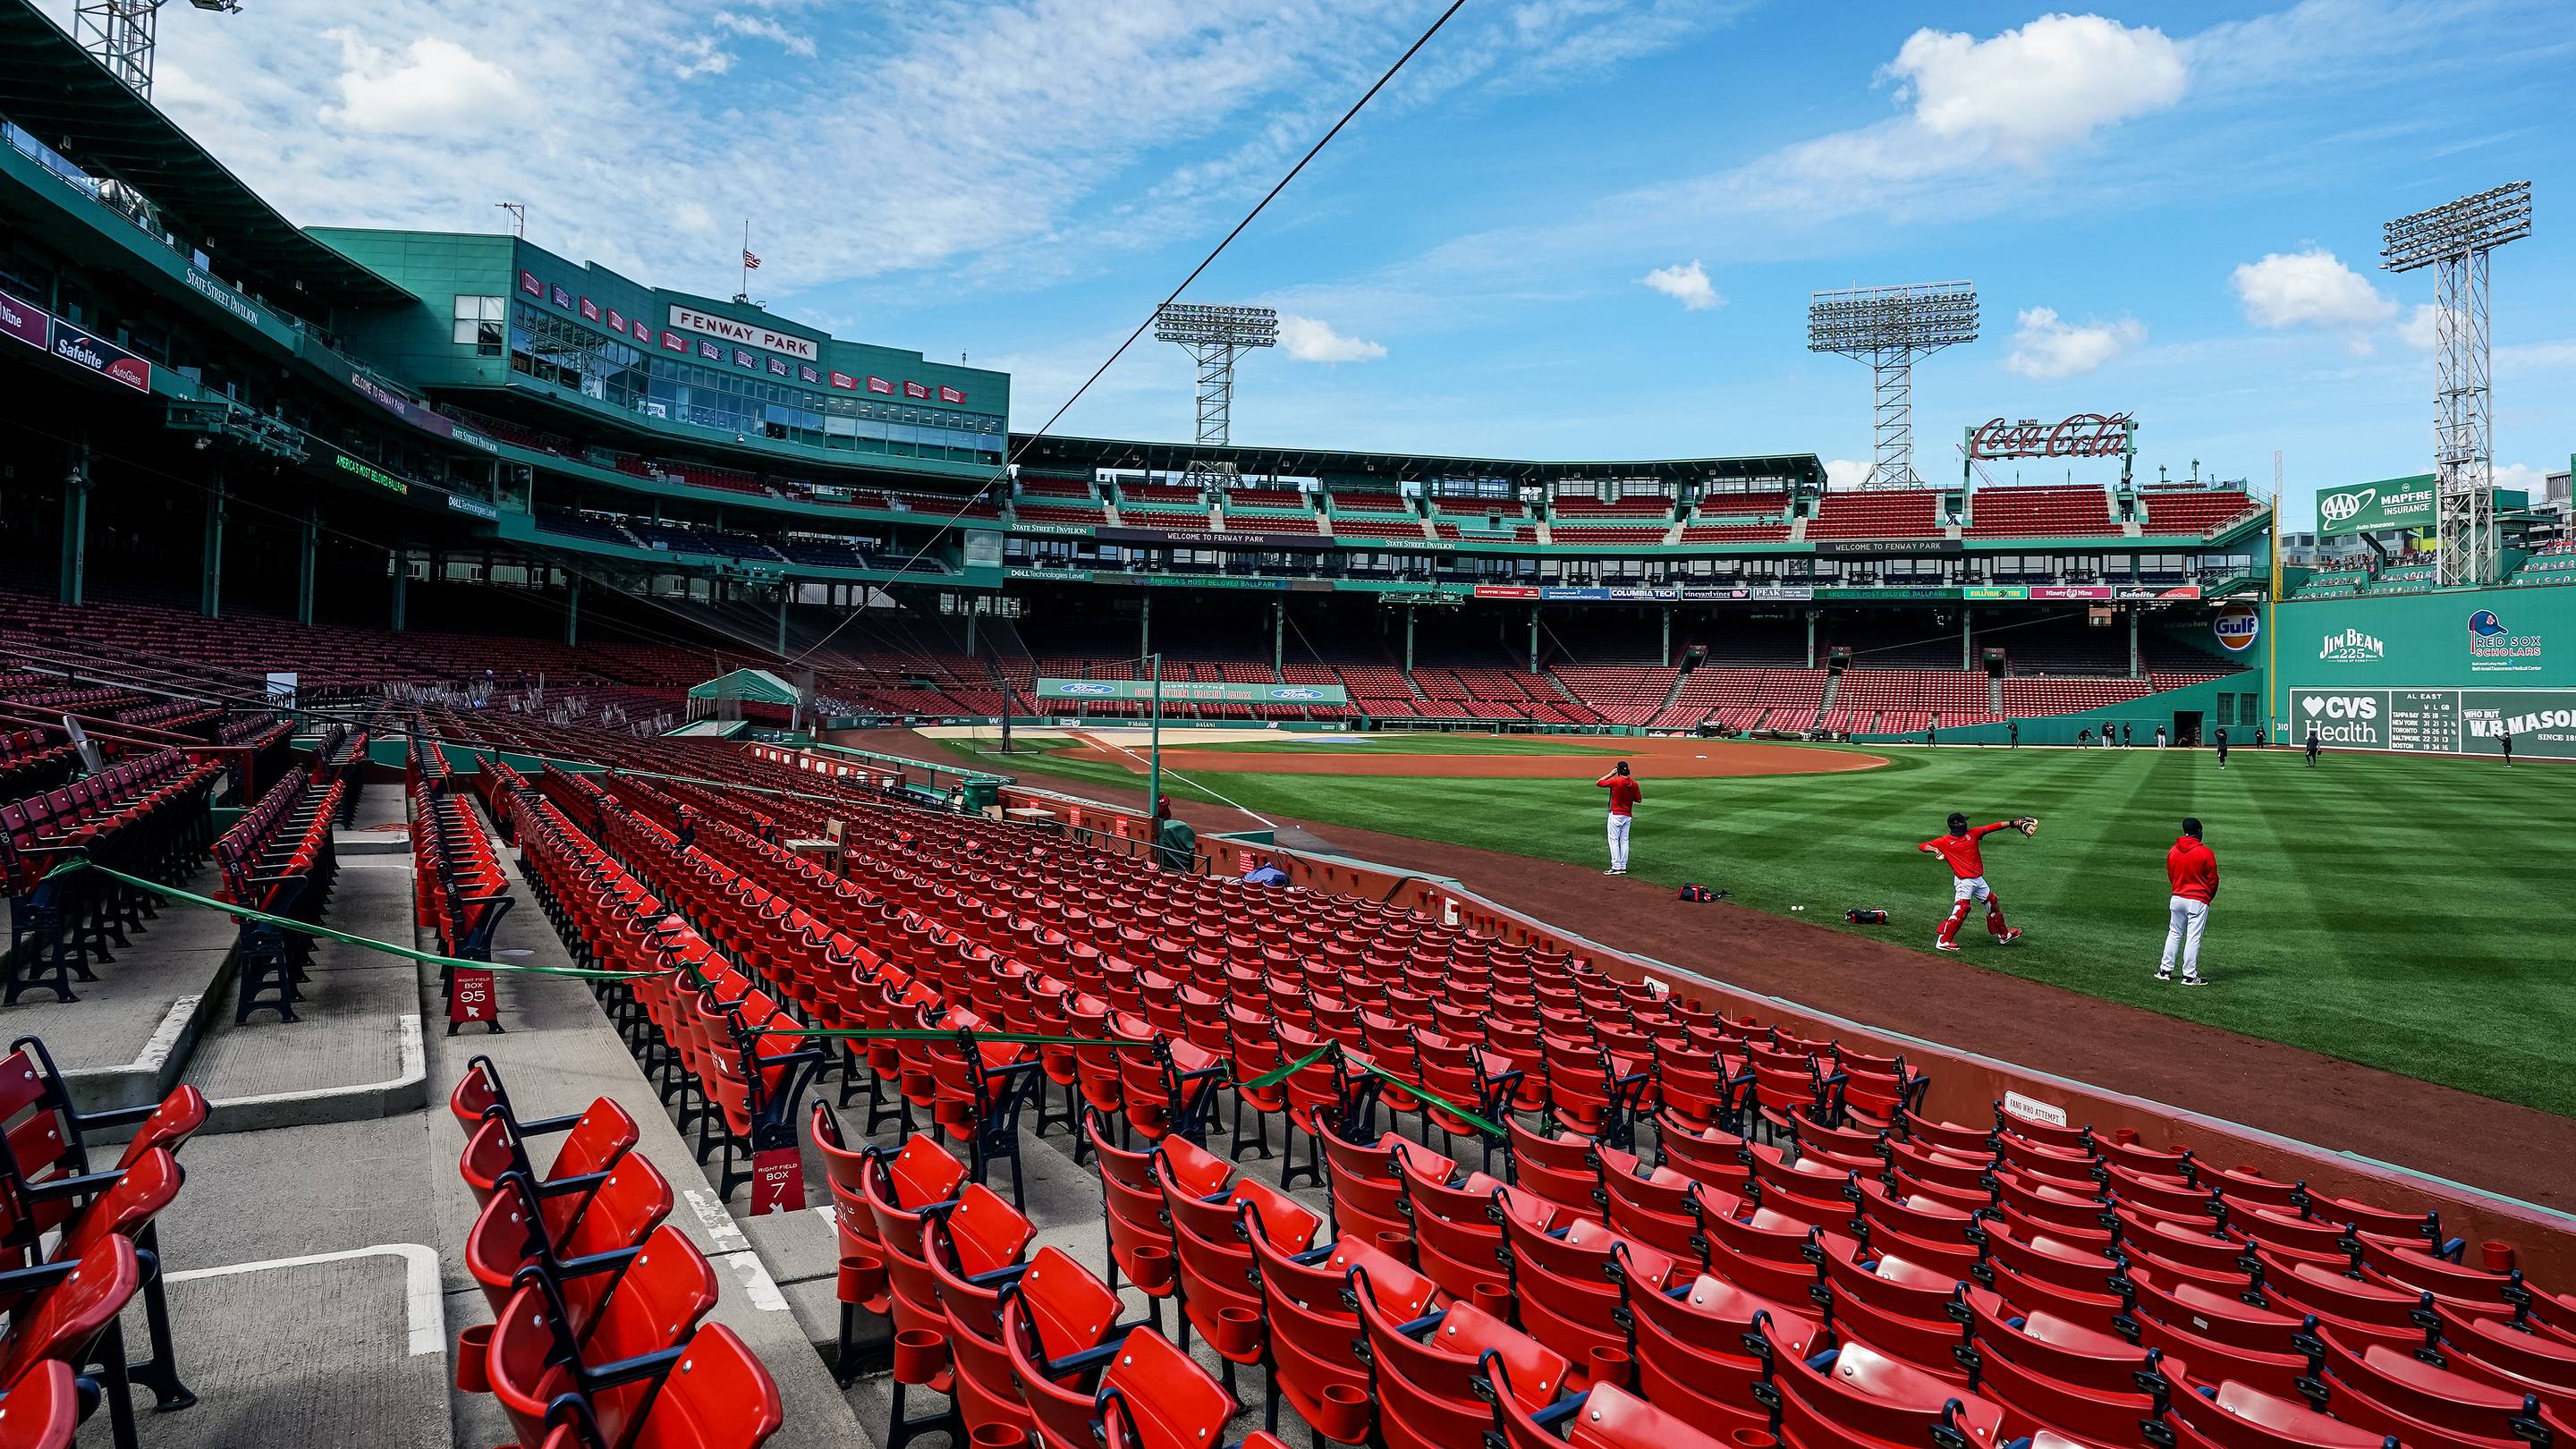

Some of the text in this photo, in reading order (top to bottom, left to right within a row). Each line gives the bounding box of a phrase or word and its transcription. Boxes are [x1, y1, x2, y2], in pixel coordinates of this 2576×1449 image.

[186, 267, 258, 326] STATE STREET PAVILION
[681, 312, 808, 355] FENWAY PARK
[58, 338, 103, 369] Safelite
[112, 364, 141, 386] AutoGlass
[352, 372, 405, 415] WELCOME TO FENWAY PARK
[1970, 411, 2133, 461] Coca-Cola
[359, 464, 371, 479] MOST
[2380, 490, 2433, 505] MAPFRE
[2384, 503, 2429, 516] INSURANCE
[1012, 523, 1087, 535] STATE STREET PAVILION
[2369, 521, 2395, 530] Insurance
[1167, 532, 1200, 540] WELCOME
[1214, 534, 1242, 542] FENWAY
[1385, 539, 1403, 547] STATE
[1403, 540, 1426, 548] STREET
[1030, 571, 1068, 580] Technologies
[2216, 617, 2255, 634] Gulf
[2320, 628, 2384, 659] JIM BEAM
[2476, 636, 2540, 647] RED SOX
[2340, 648, 2365, 659] 225
[2476, 648, 2541, 657] SCHOLARS
[1194, 689, 1221, 699] RED
[1226, 691, 1251, 699] SOX
[2326, 696, 2377, 719] CVS
[2484, 710, 2500, 718] BUT
[2276, 723, 2289, 731] 310
[2305, 720, 2377, 743] Health
[2538, 733, 2564, 741] SINCE
[461, 990, 486, 1003] 95
[741, 1041, 750, 1049] K
[2010, 1099, 2059, 1123] FANS WHO ATTEMPT
[758, 1165, 778, 1173] RIGHT
[766, 1171, 789, 1181] BOX
[771, 1182, 786, 1199] 7
